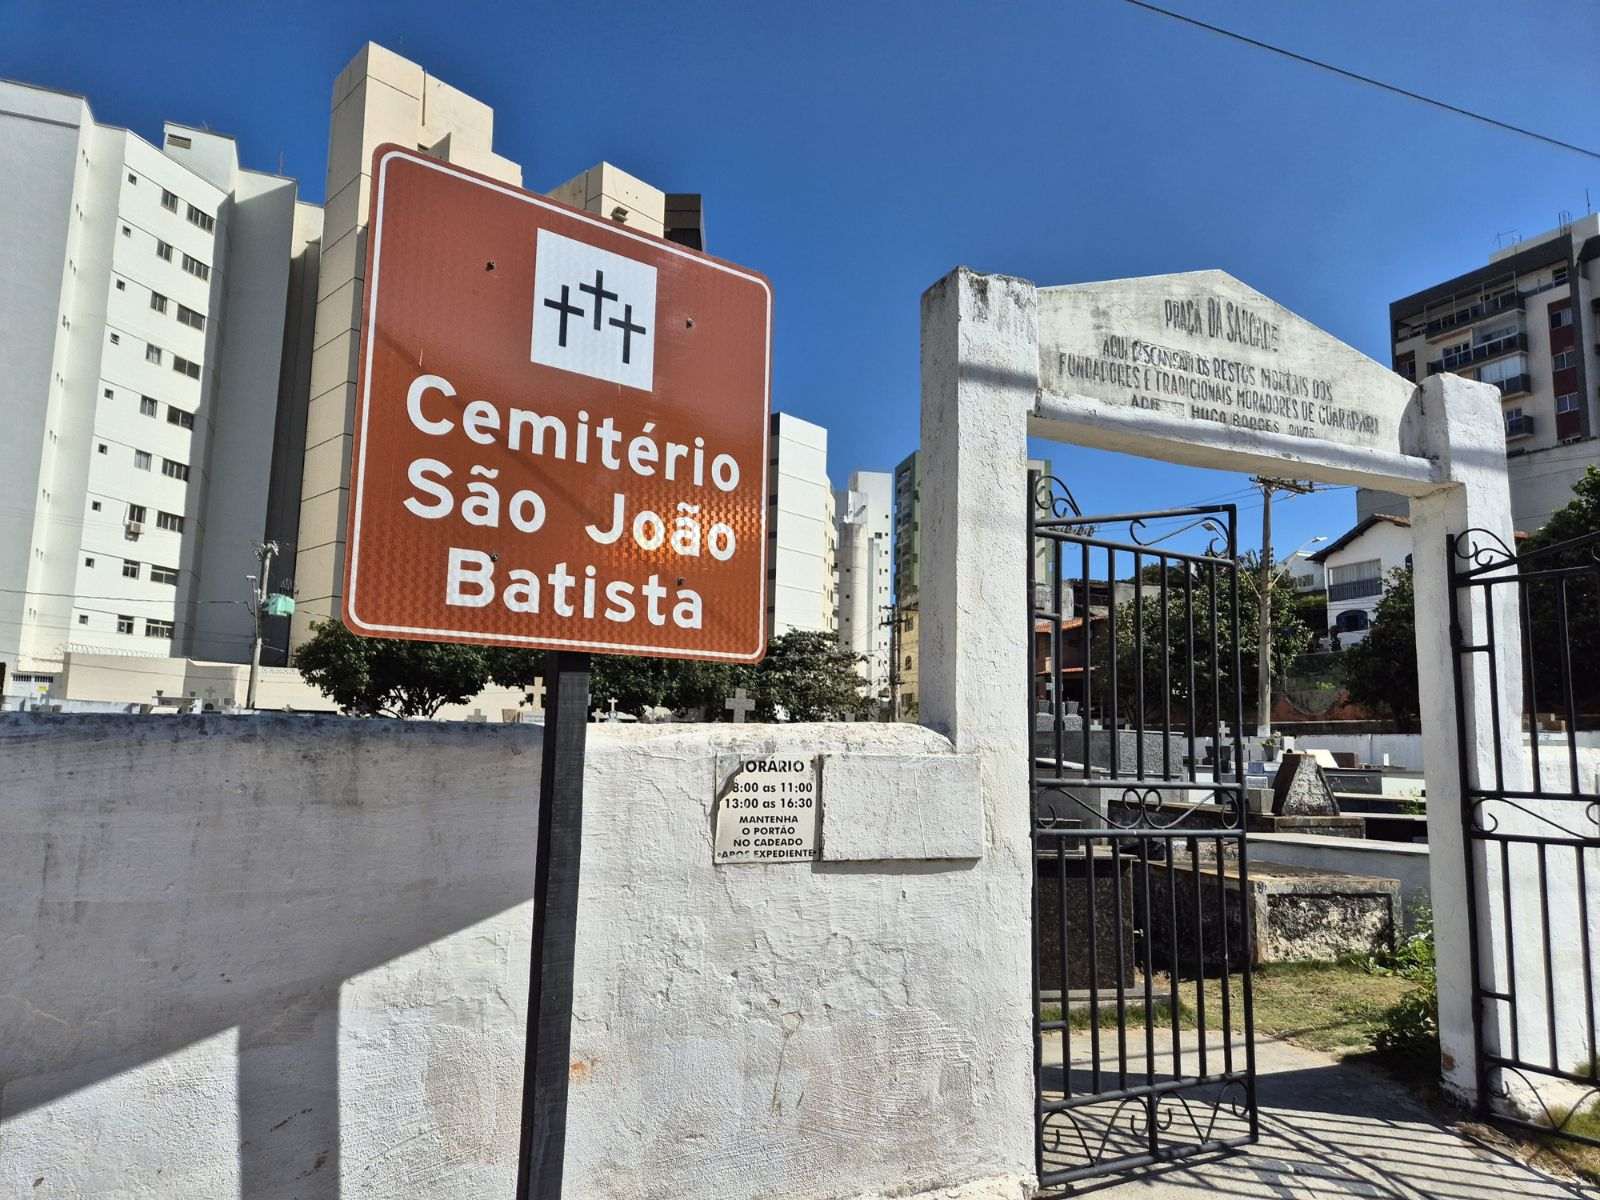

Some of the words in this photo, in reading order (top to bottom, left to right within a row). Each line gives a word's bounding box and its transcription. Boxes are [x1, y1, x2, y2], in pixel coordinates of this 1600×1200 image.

[1208, 297, 1223, 338] DA
[1058, 352, 1141, 389] FUNDADORES
[1144, 370, 1151, 391] E
[1154, 371, 1233, 406] TRADICIONAIS
[1237, 389, 1299, 420] MORADORES
[1302, 402, 1315, 423] DE
[1213, 357, 1256, 386] RESTOS
[1313, 379, 1333, 402] DOS
[406, 375, 740, 492] Cemitério
[403, 458, 546, 533] São
[586, 493, 736, 561] João
[445, 546, 703, 630] Batista
[725, 798, 759, 809] 13:00
[762, 800, 776, 809] as
[781, 798, 813, 809] 16:30
[762, 784, 776, 793] as
[780, 782, 813, 793] 11:00
[739, 815, 799, 824] MANTENHA
[742, 827, 750, 835] O
[754, 825, 795, 835] PORTÃO
[733, 839, 751, 847] NO
[754, 838, 803, 847] CADEADO
